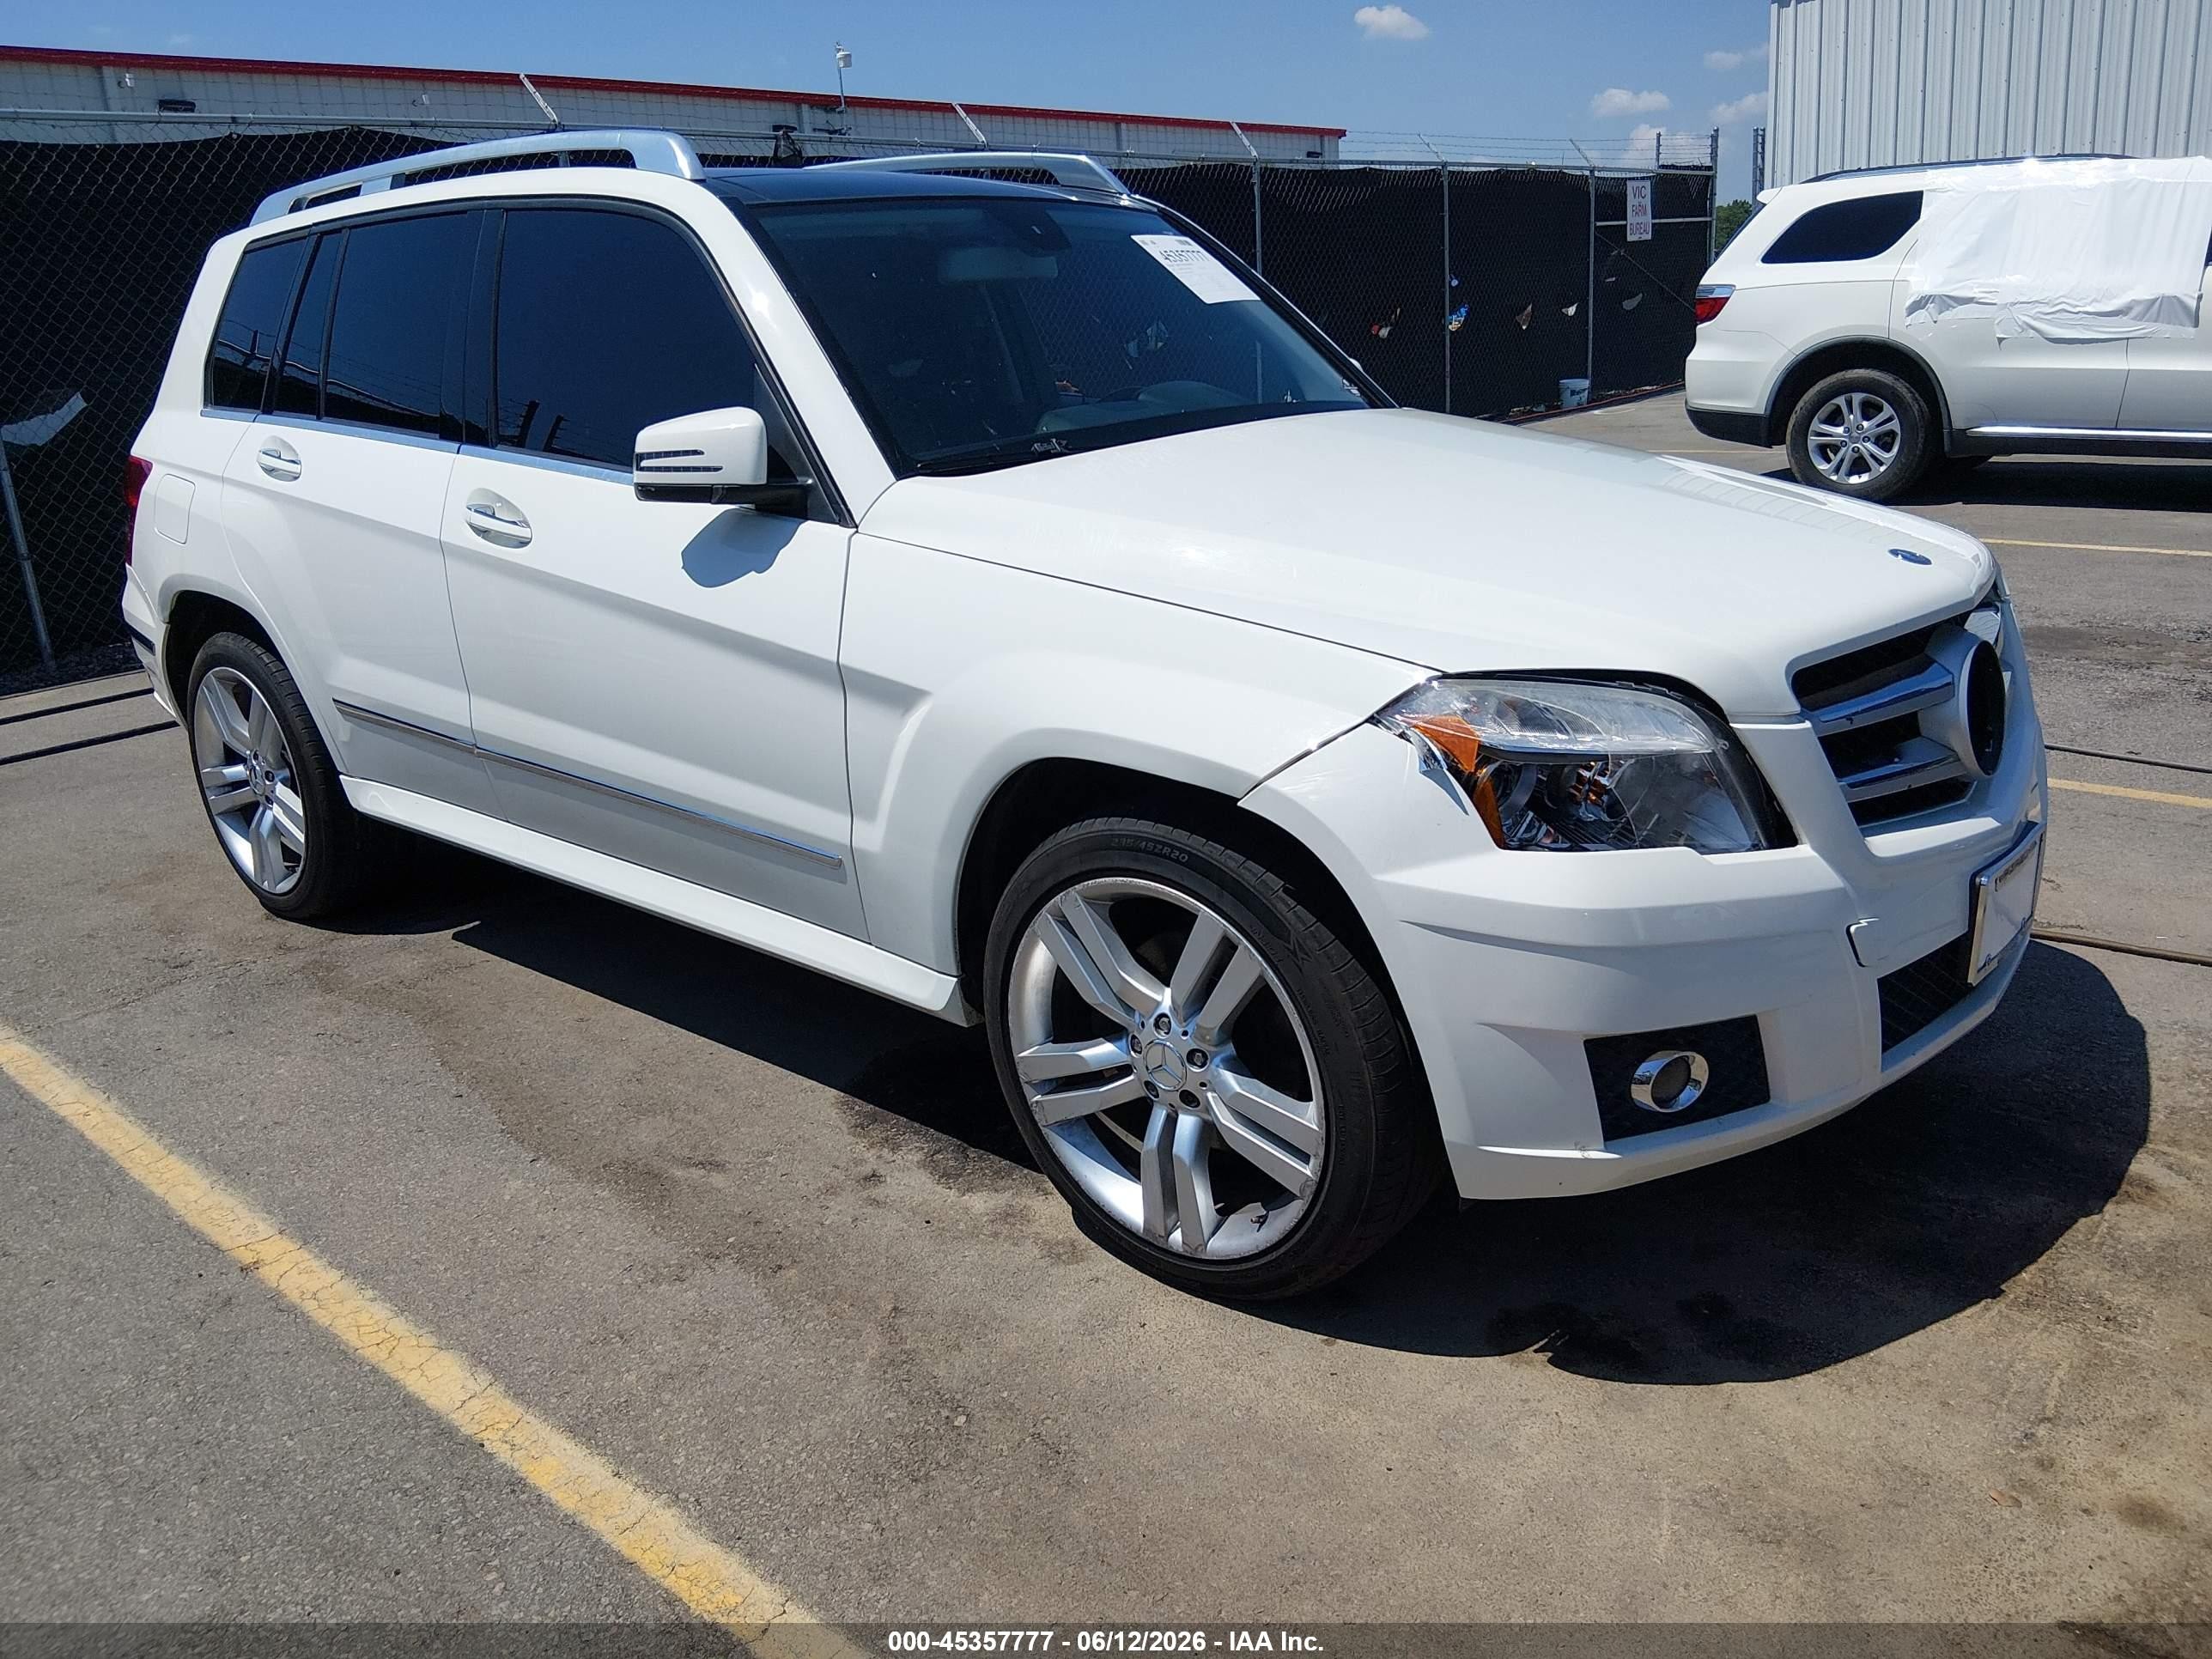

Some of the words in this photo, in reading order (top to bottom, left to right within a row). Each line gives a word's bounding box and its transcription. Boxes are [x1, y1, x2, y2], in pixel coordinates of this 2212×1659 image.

[1632, 185, 1647, 199] VIC
[1632, 204, 1647, 218] FARM
[1629, 222, 1650, 236] BUREAU
